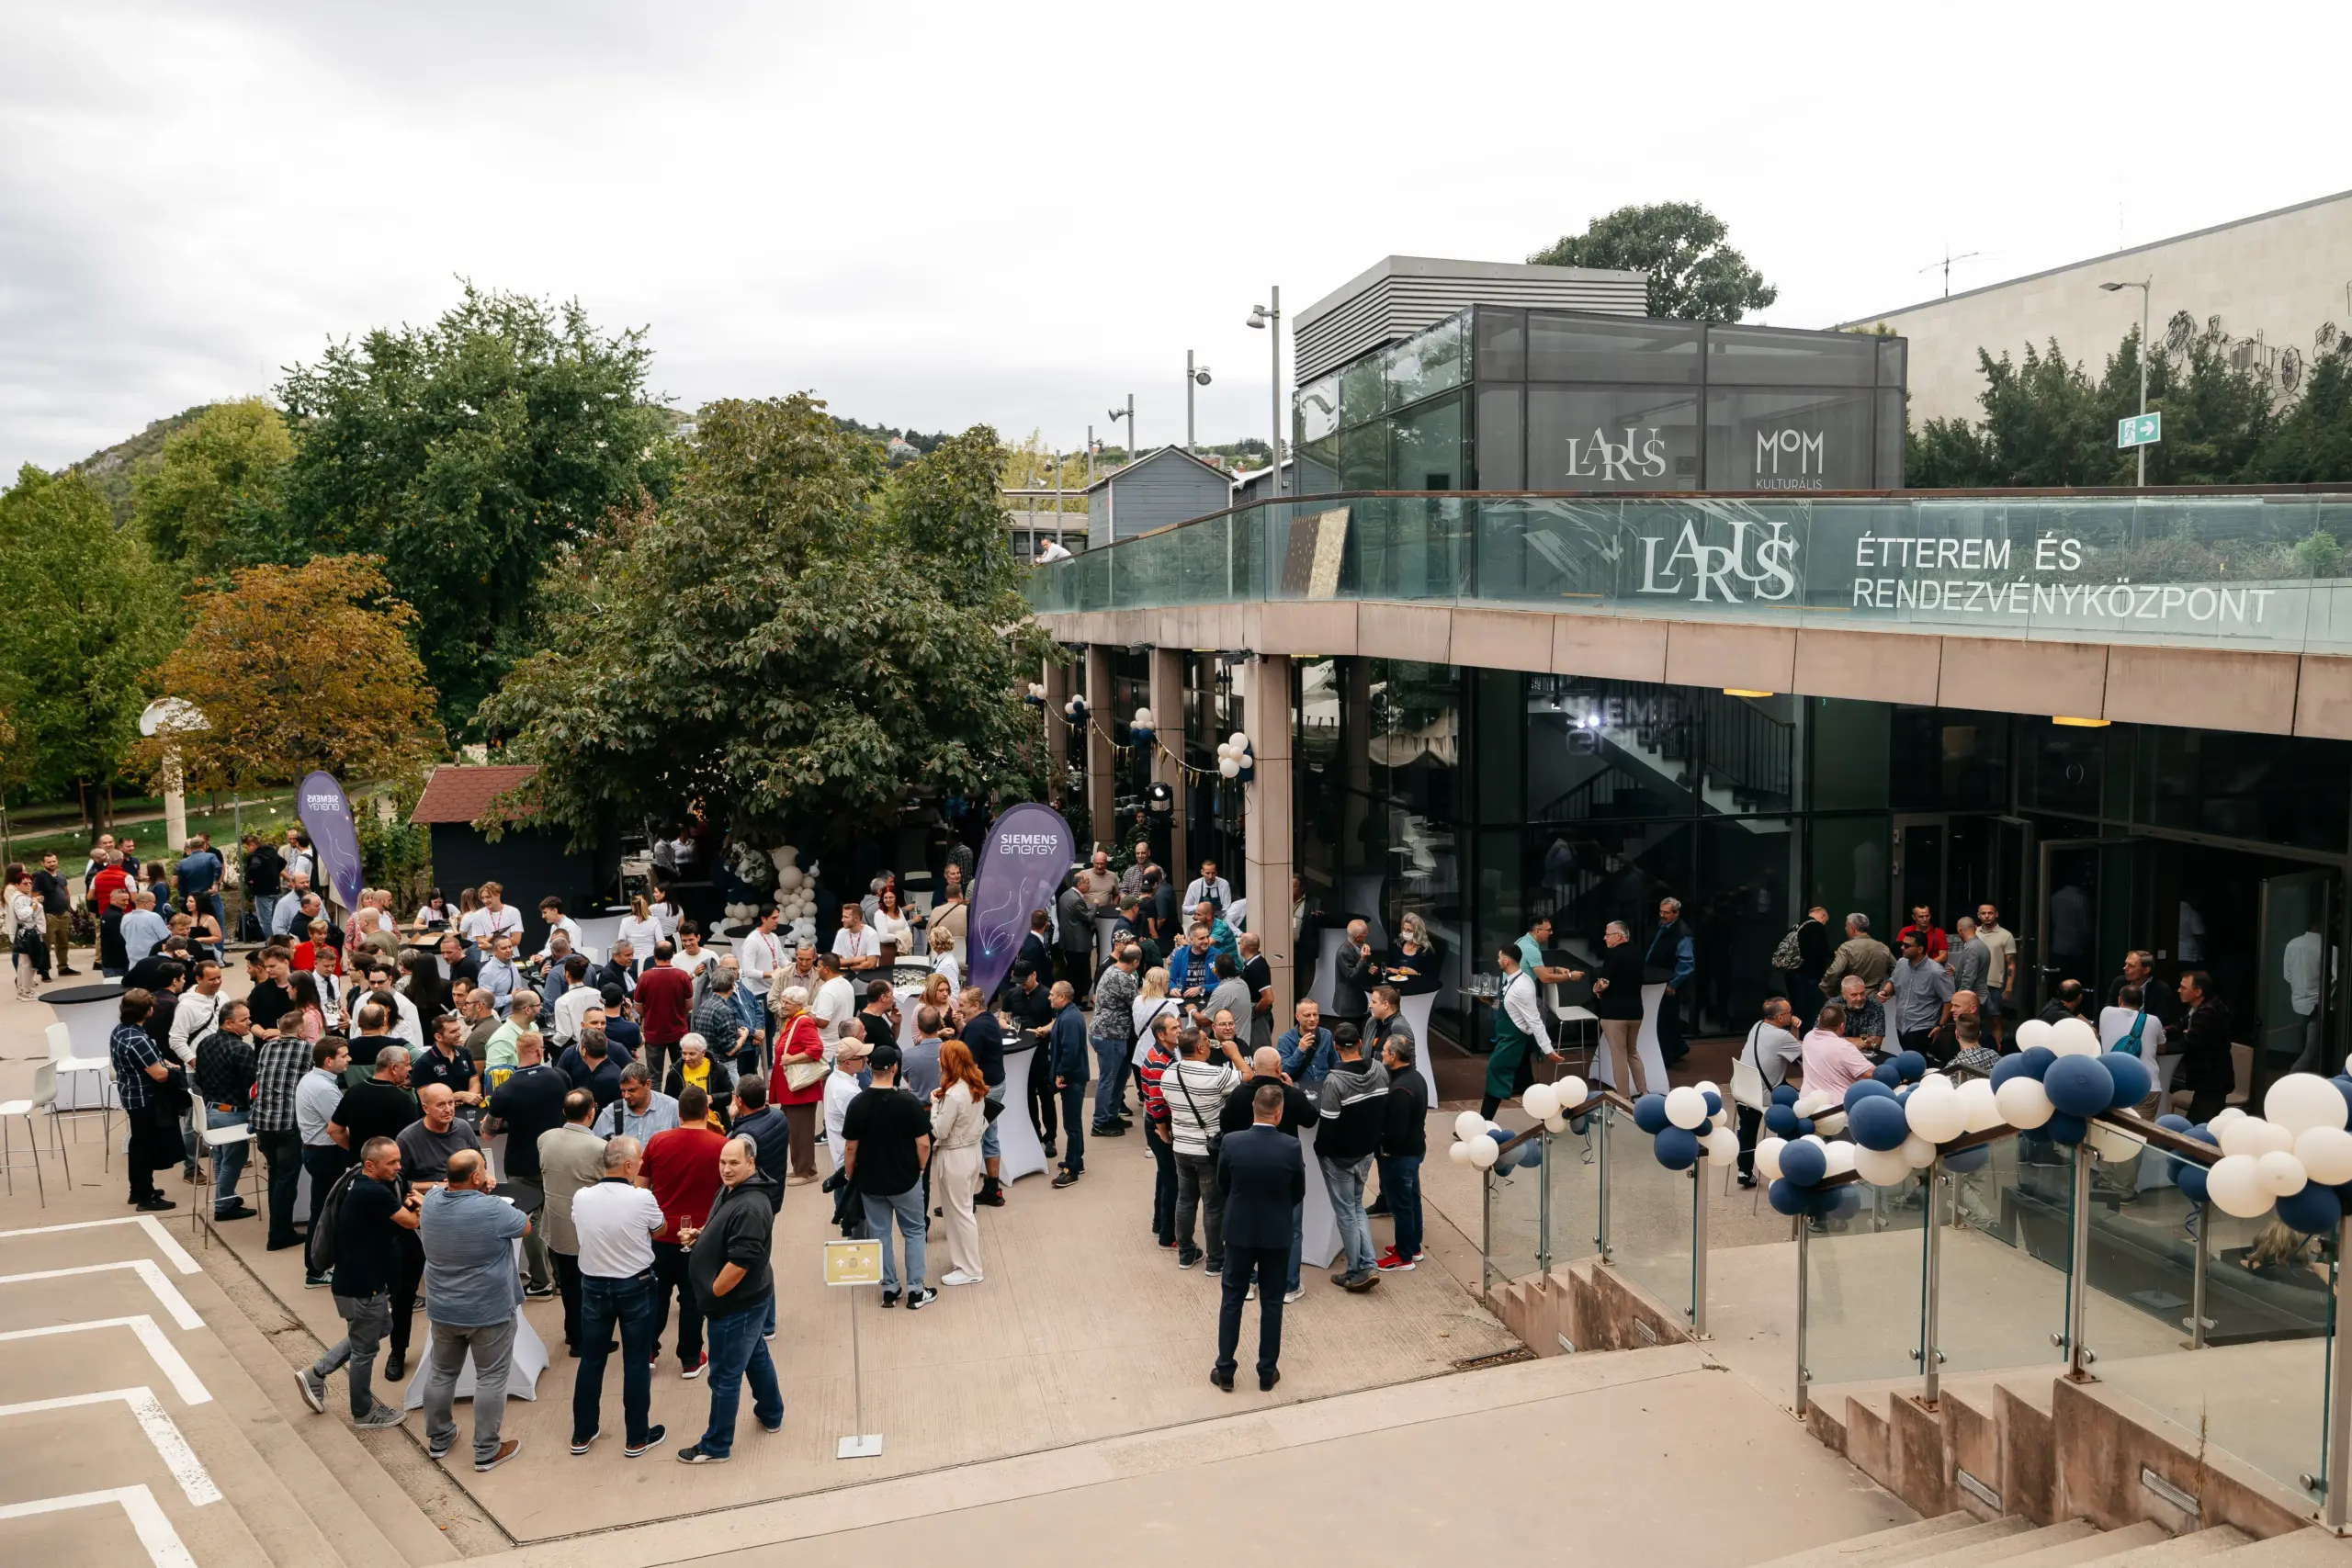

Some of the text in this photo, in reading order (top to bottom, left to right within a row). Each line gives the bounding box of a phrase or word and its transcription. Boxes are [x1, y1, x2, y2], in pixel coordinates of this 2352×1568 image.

[1565, 427, 1666, 480] LARUS
[1756, 477, 1823, 490] KULTURÁLIS
[1636, 519, 1795, 603] LARUS
[1856, 530, 2082, 571] ÉTTEREM ÉS
[1853, 576, 2275, 623] RENDEZVÉNYKÖZPONT
[1001, 834, 1057, 844] SIEMENS
